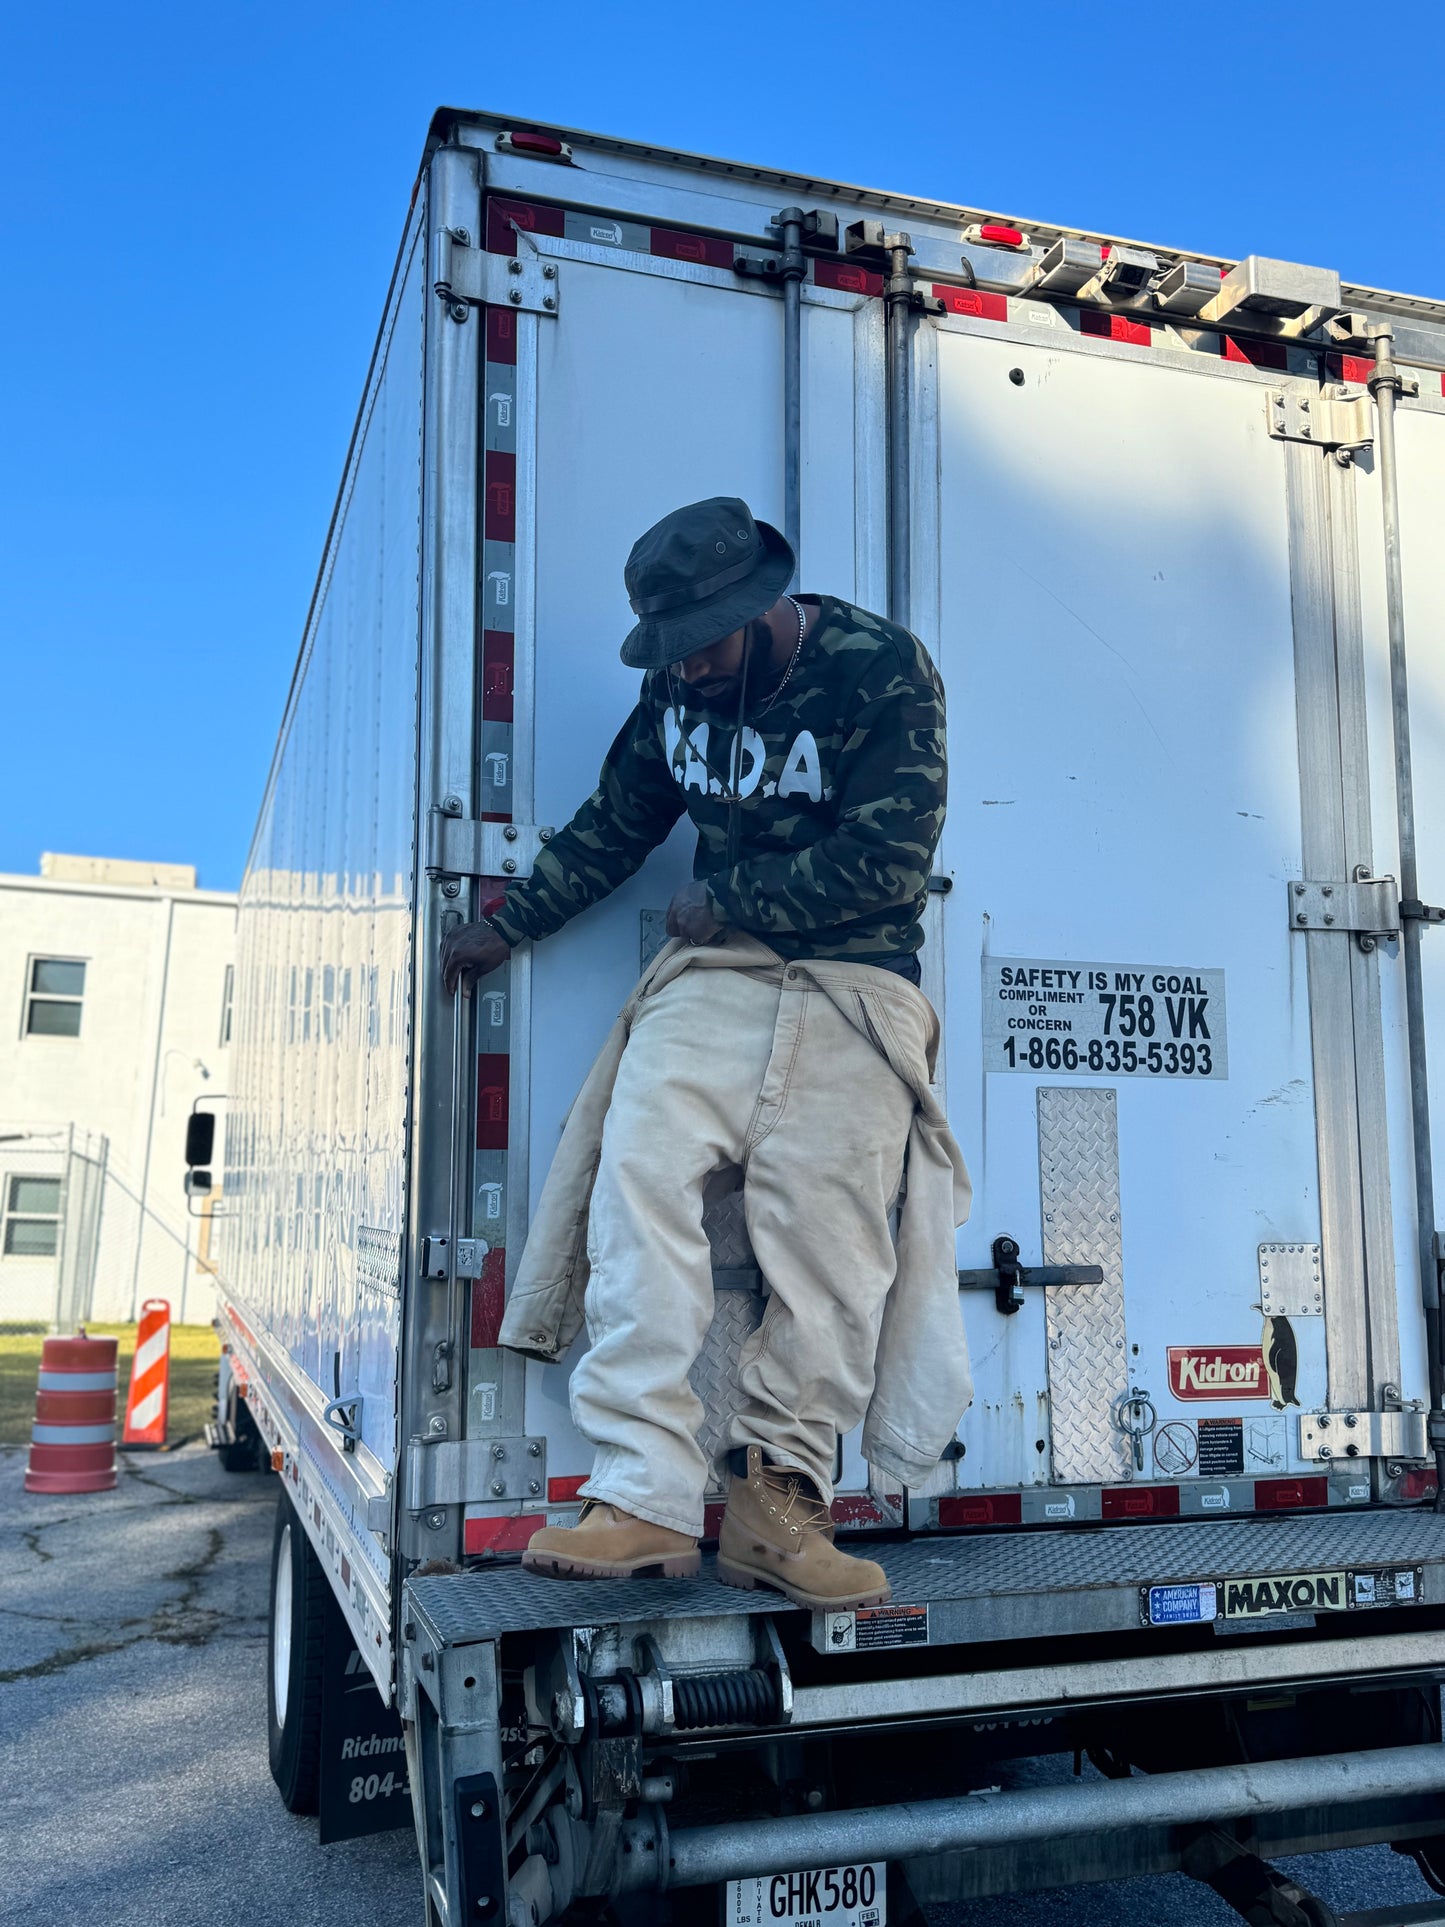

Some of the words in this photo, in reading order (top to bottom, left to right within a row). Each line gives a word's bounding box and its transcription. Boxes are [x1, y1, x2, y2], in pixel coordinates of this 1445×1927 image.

[1000, 966, 1081, 989] SAFETY
[1088, 972, 1108, 991] IS
[1115, 973, 1145, 992] MY
[1152, 975, 1208, 995] GOAL
[999, 989, 1084, 1004] COMPLIMENT
[1028, 1005, 1047, 1016] OR
[1099, 993, 1155, 1038] 758
[1165, 996, 1211, 1039] VK
[1008, 1018, 1072, 1032] CONCERN
[1003, 1036, 1213, 1075] 1-866-835-5393
[1179, 1357, 1260, 1390] Kidron
[1162, 1587, 1198, 1601] AMERICAN
[1227, 1577, 1339, 1614] MAXON
[1162, 1599, 1198, 1612] COMPANY
[769, 1865, 876, 1918] GHK580
[737, 1915, 751, 1924] LBS
[861, 1912, 876, 1921] FEB
